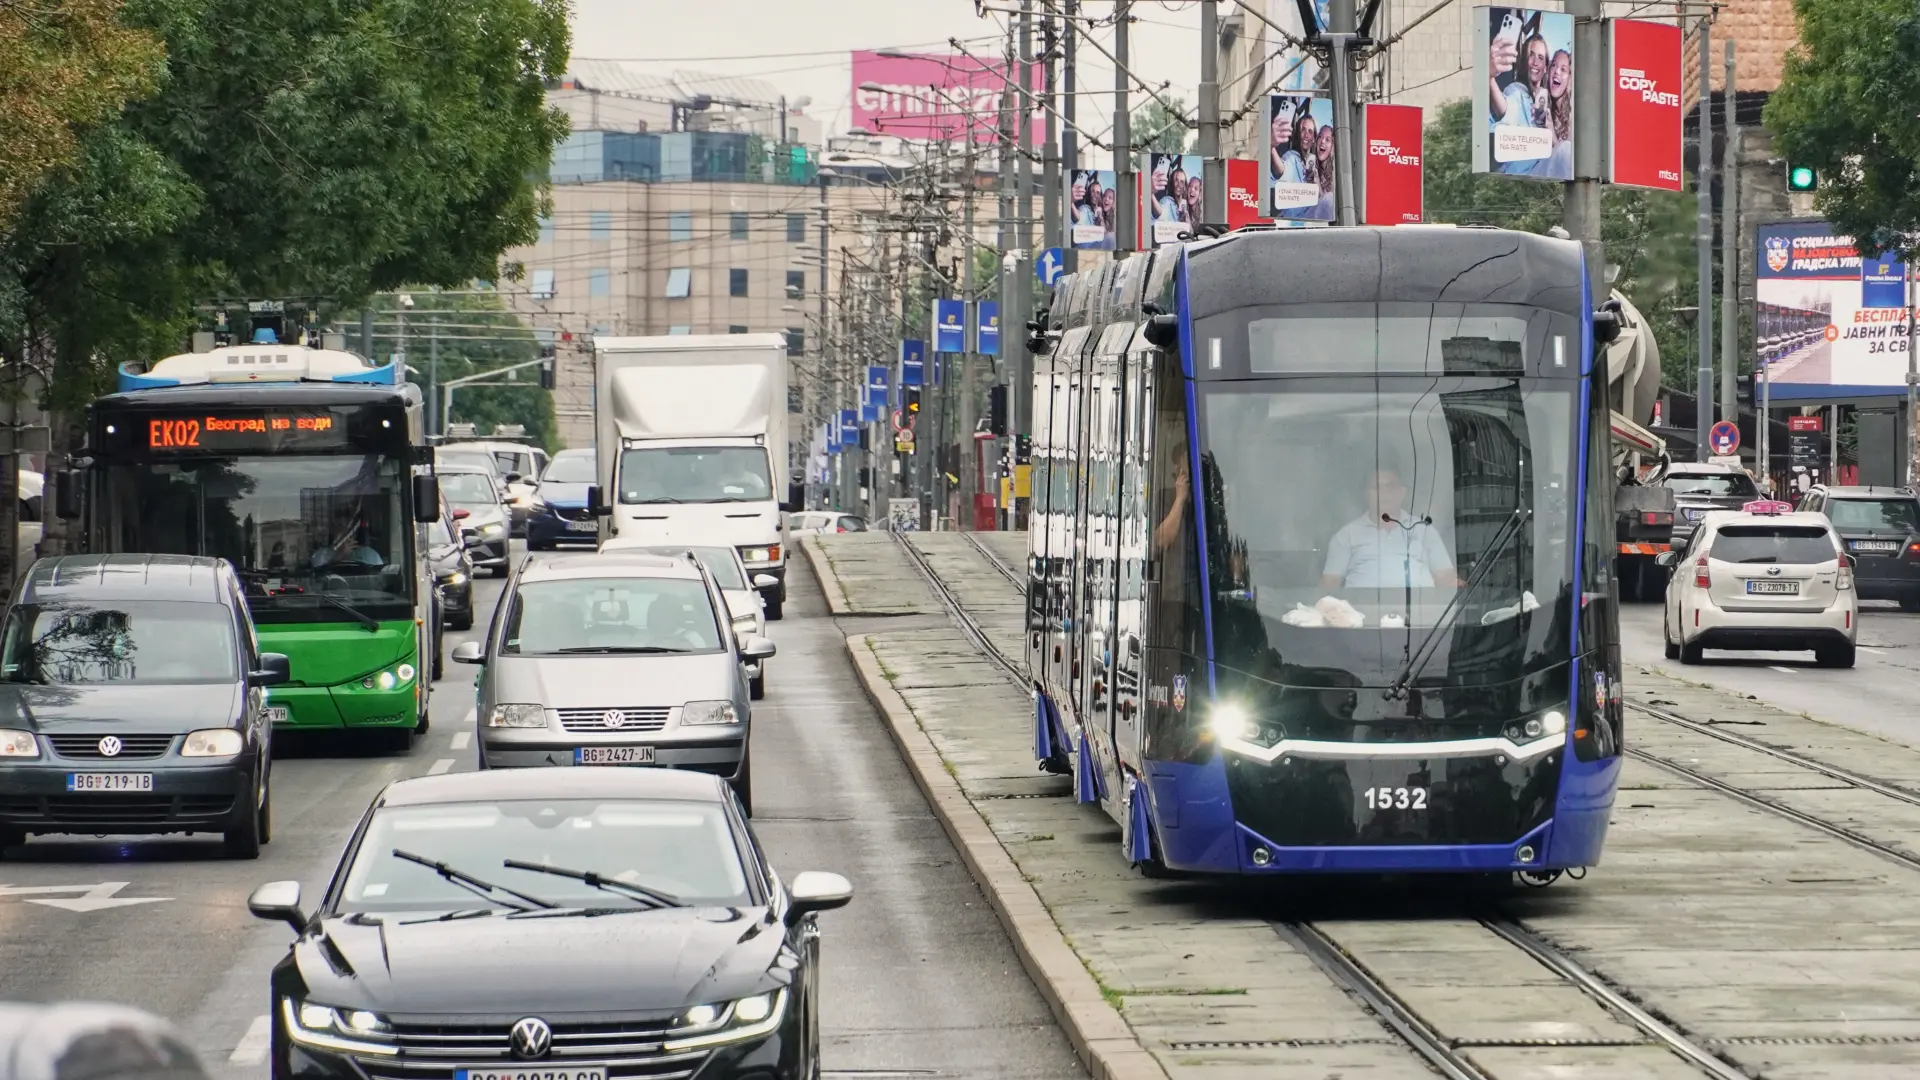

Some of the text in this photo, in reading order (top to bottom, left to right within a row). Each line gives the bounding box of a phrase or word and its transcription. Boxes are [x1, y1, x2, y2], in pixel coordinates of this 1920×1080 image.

[1620, 76, 1656, 91] COPY
[1642, 90, 1679, 106] PASTE
[1518, 135, 1549, 145] TELEFONA
[1370, 146, 1400, 156] COPY
[1511, 144, 1528, 152] RATE
[1389, 155, 1420, 166] PASTE
[1229, 192, 1254, 201] COPY
[1792, 258, 1839, 271] ГРАДСКА
[1843, 327, 1886, 340] ЈАВНИ
[1869, 340, 1911, 353] ЗА СВ
[205, 417, 266, 432] Београд
[296, 417, 331, 431] води
[1752, 583, 1763, 592] BG
[583, 748, 653, 762] BG 2427-JN
[77, 775, 93, 789] BG
[1364, 787, 1427, 809] 1532
